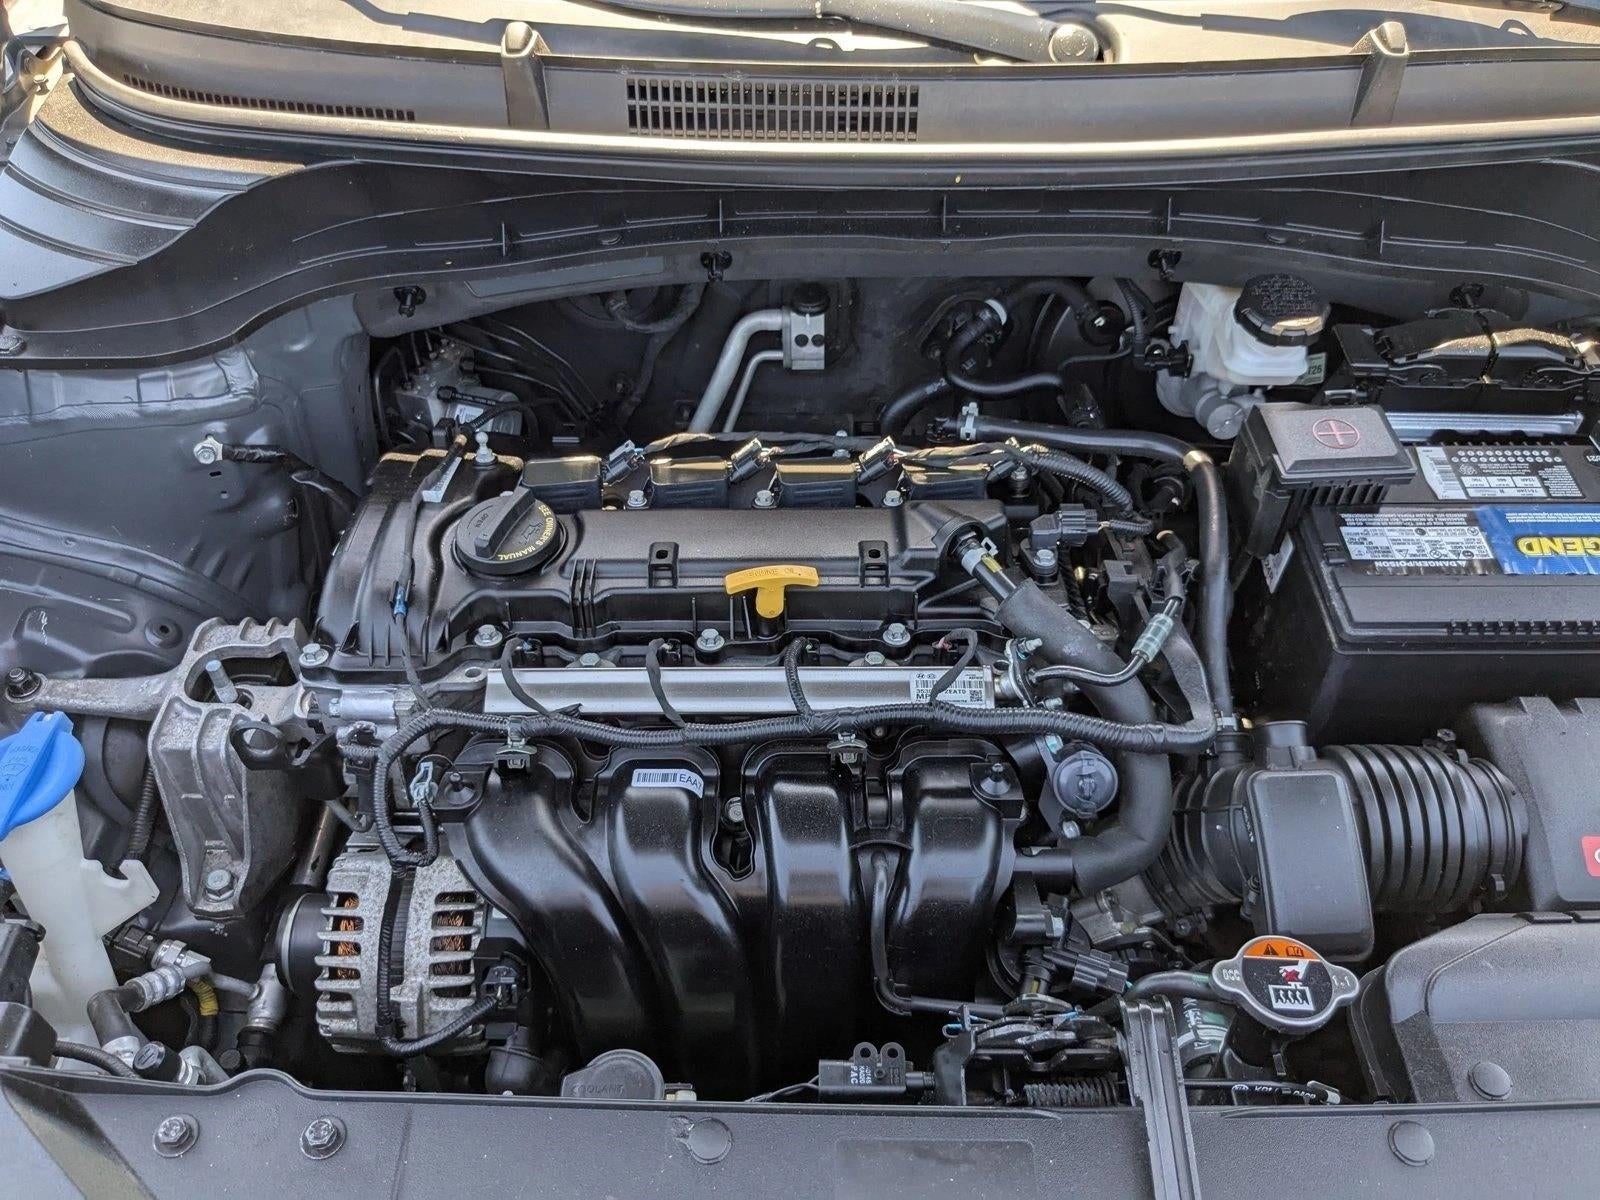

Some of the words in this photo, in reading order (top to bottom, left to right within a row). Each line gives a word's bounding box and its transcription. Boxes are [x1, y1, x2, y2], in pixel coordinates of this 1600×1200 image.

[538, 504, 552, 517] SEE
[535, 518, 555, 547] OWNER'S
[497, 545, 537, 561] MANUAL
[850, 1064, 859, 1085] PAC
